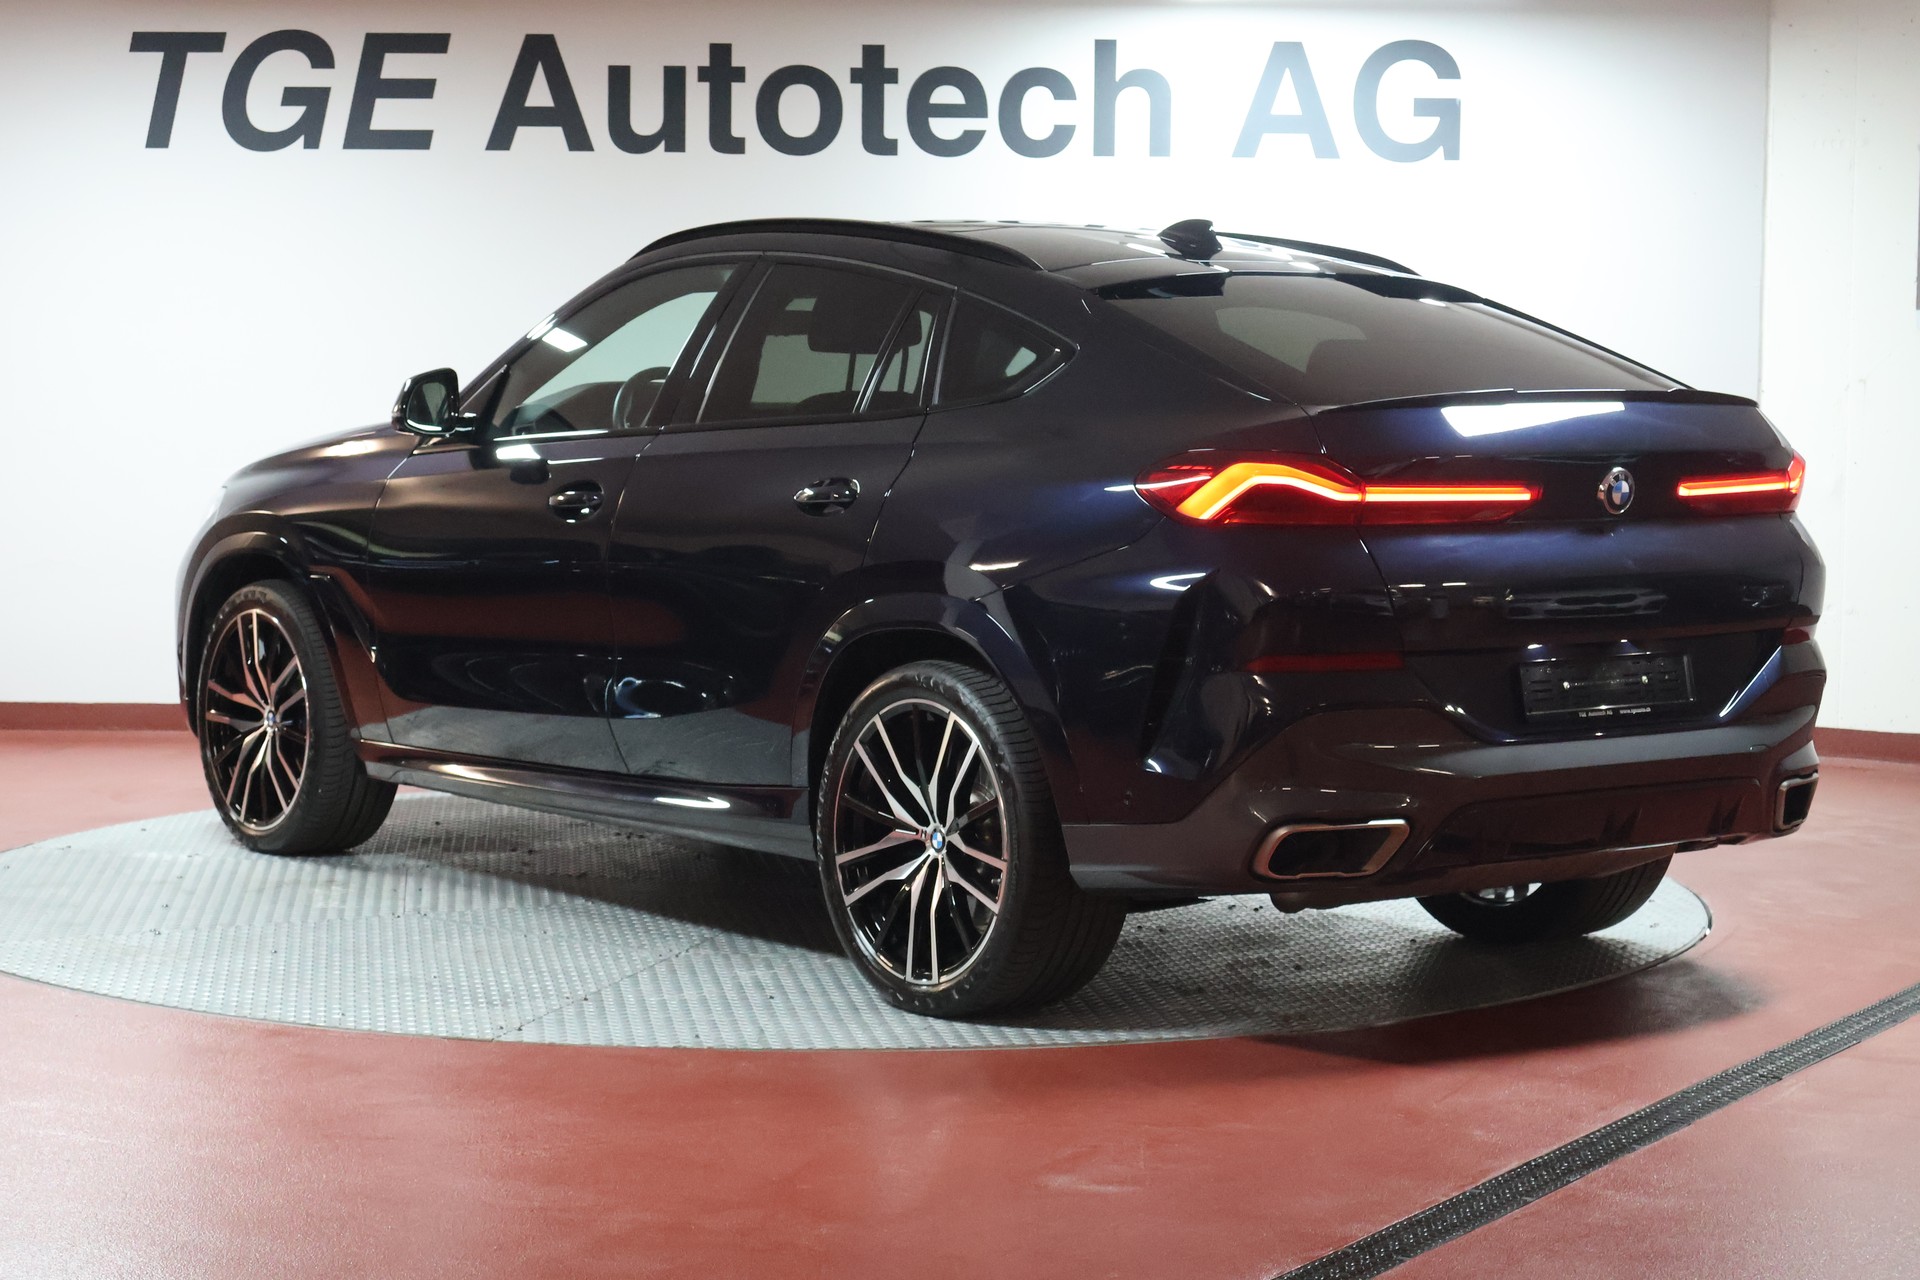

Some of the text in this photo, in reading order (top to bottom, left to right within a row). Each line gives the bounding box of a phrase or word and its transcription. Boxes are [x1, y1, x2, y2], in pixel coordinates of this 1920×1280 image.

[129, 29, 1462, 163] TGE Autotech AG
